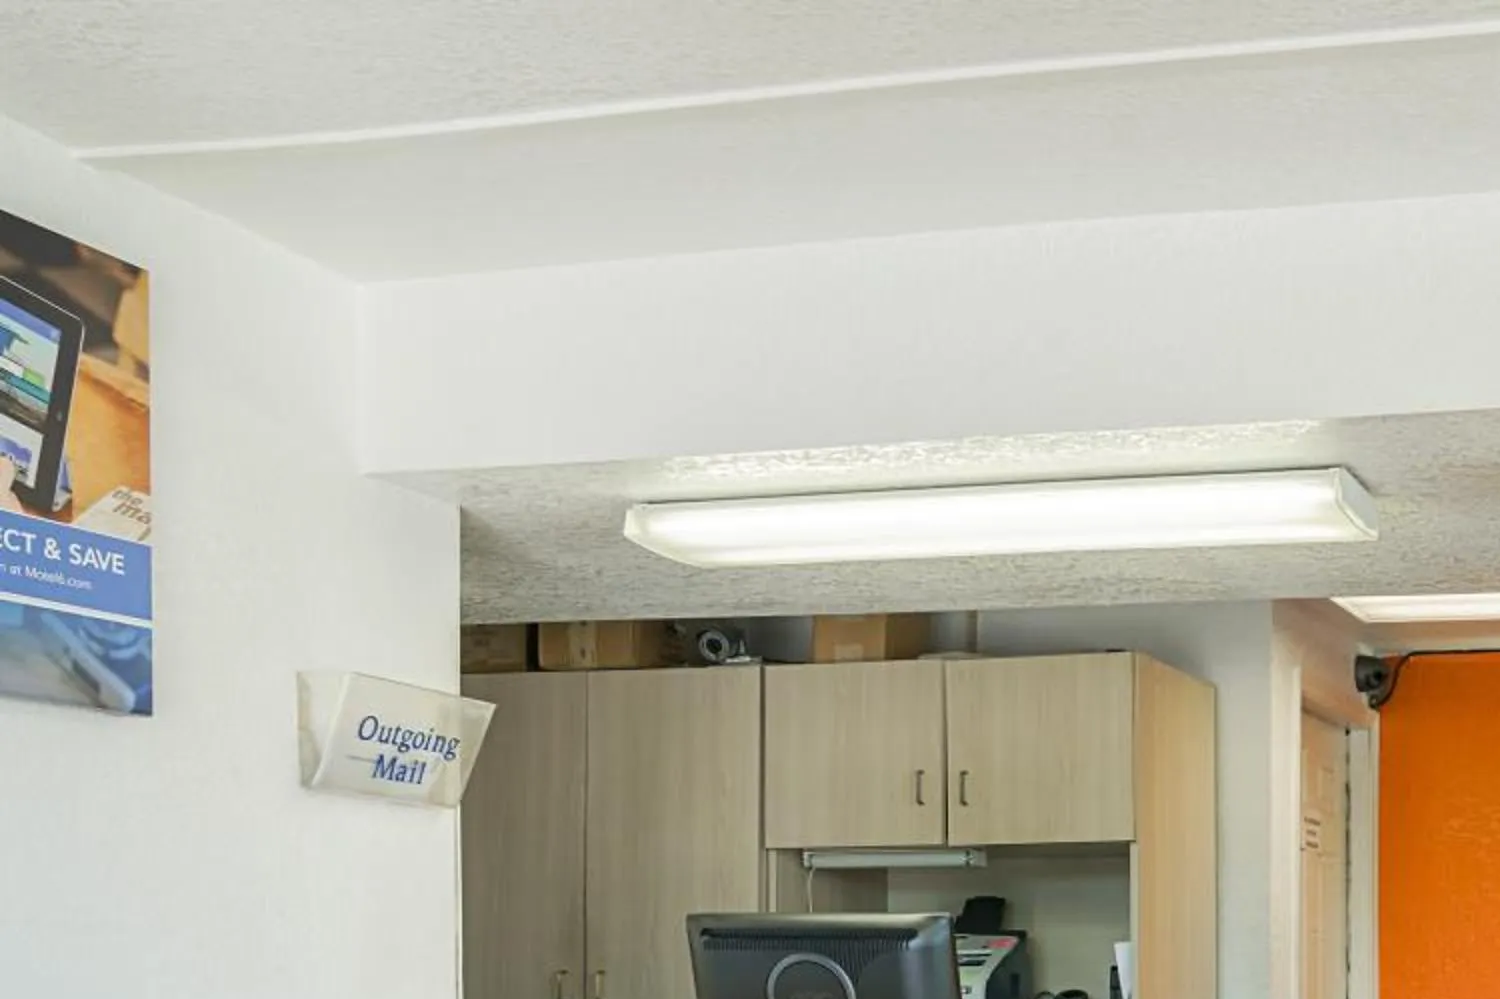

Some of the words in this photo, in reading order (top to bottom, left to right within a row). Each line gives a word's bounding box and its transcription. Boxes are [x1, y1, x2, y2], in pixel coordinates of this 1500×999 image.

[0, 527, 37, 555] CT
[43, 537, 61, 561] &
[69, 543, 125, 575] SAVE
[358, 715, 461, 762] Outgoing
[371, 753, 427, 785] Mail
